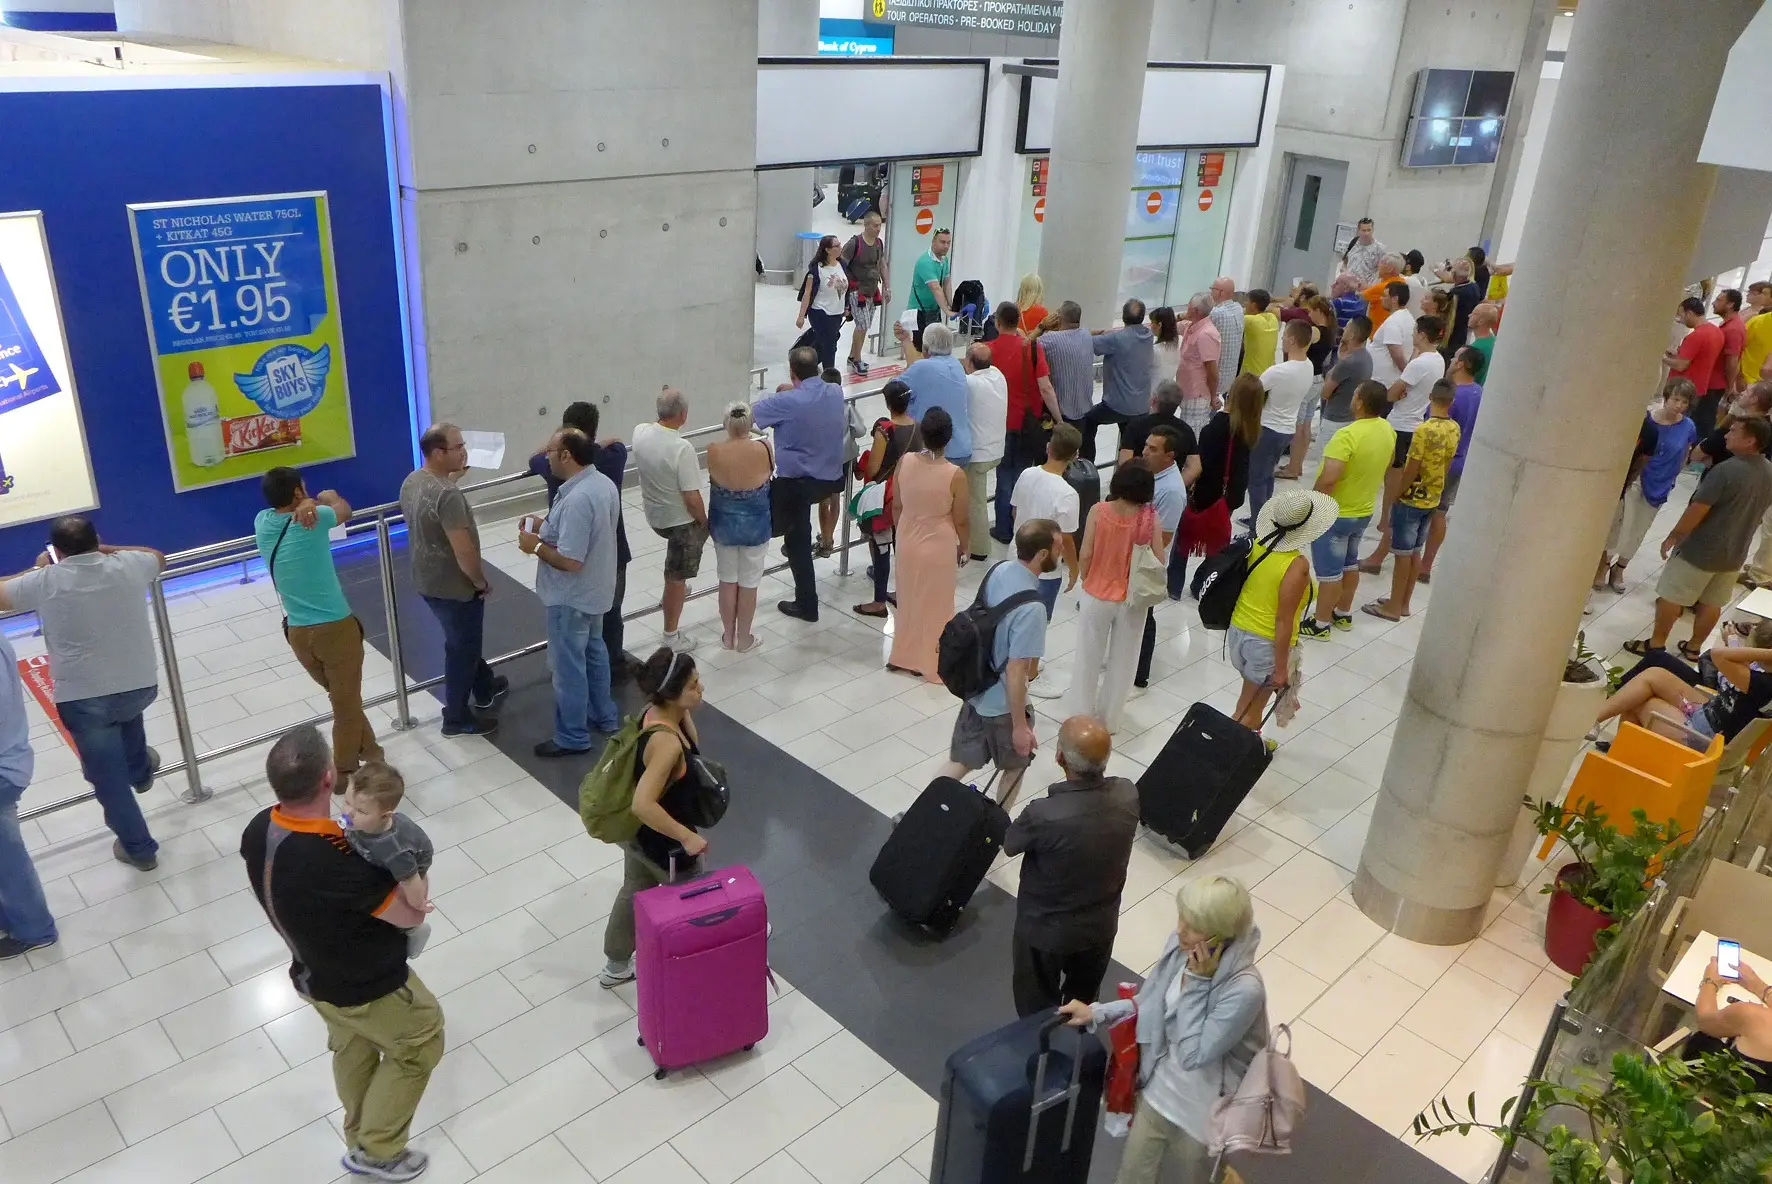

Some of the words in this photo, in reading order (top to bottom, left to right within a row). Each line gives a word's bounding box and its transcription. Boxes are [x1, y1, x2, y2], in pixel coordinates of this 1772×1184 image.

[983, 1, 1051, 16] ΠΡΟΚΡΑΤΗΜΕΝΑ
[887, 10, 906, 21] TOUR
[909, 12, 954, 25] OPERATORS
[960, 15, 1015, 31] PRE-BOOKED
[1017, 20, 1056, 34] HOLIDAY
[839, 41, 849, 51] of
[1136, 152, 1154, 163] can
[1157, 153, 1182, 169] trust
[153, 219, 167, 229] ST
[171, 213, 232, 228] NICHOLAS
[233, 210, 273, 223] WATER
[276, 208, 302, 219] 75CL
[166, 228, 208, 241] KITKAT
[211, 226, 233, 237] 45G
[161, 241, 285, 288] ONLY
[168, 281, 291, 334] €1.95
[273, 363, 297, 384] SKY
[275, 377, 308, 400] BUYS
